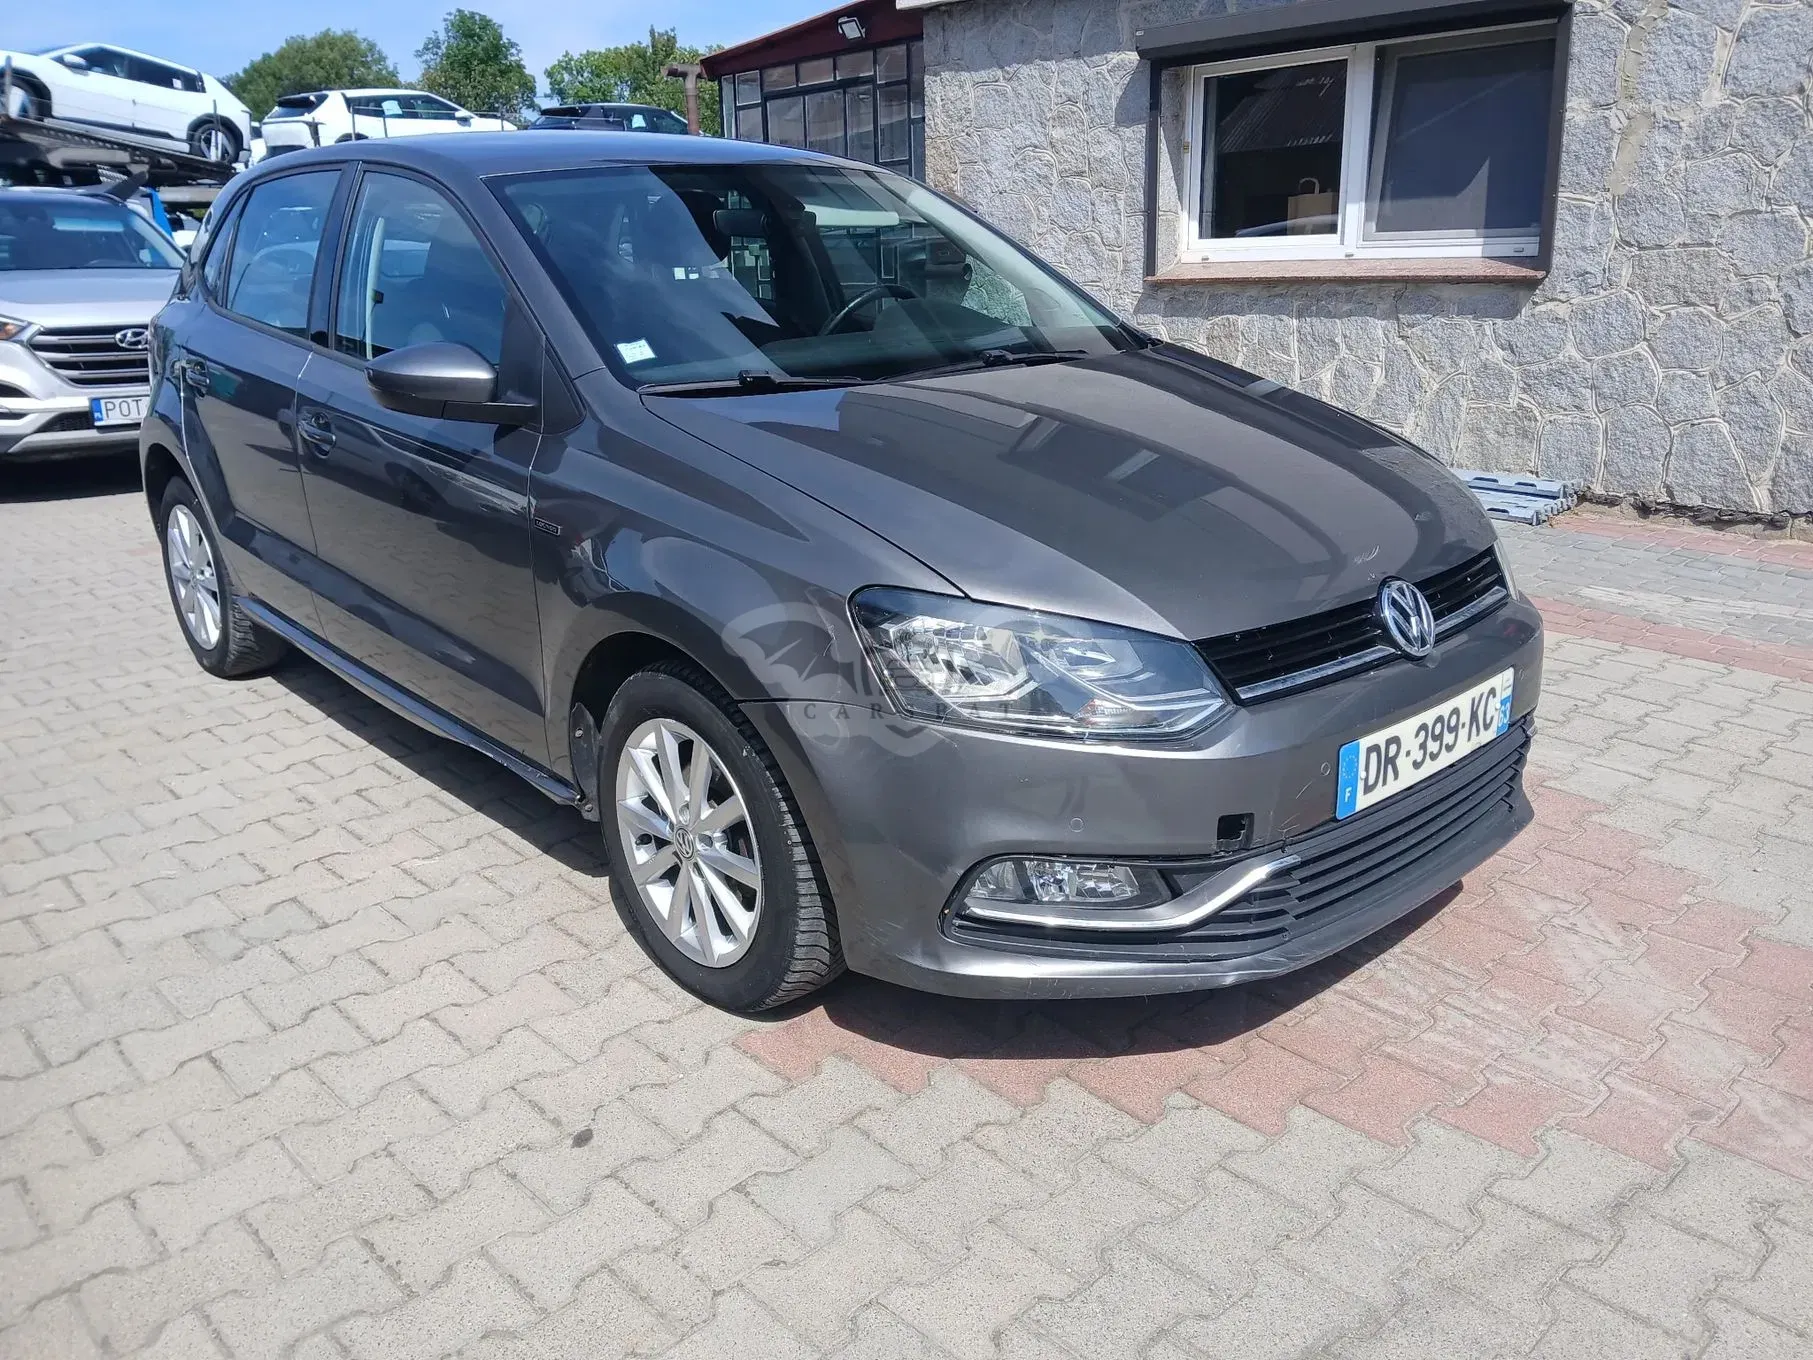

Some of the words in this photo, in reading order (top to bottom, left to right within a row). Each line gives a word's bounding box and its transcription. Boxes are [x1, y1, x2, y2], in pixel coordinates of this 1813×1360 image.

[104, 399, 143, 419] POT
[1344, 786, 1352, 803] F
[1363, 687, 1497, 795] DR-399-KC
